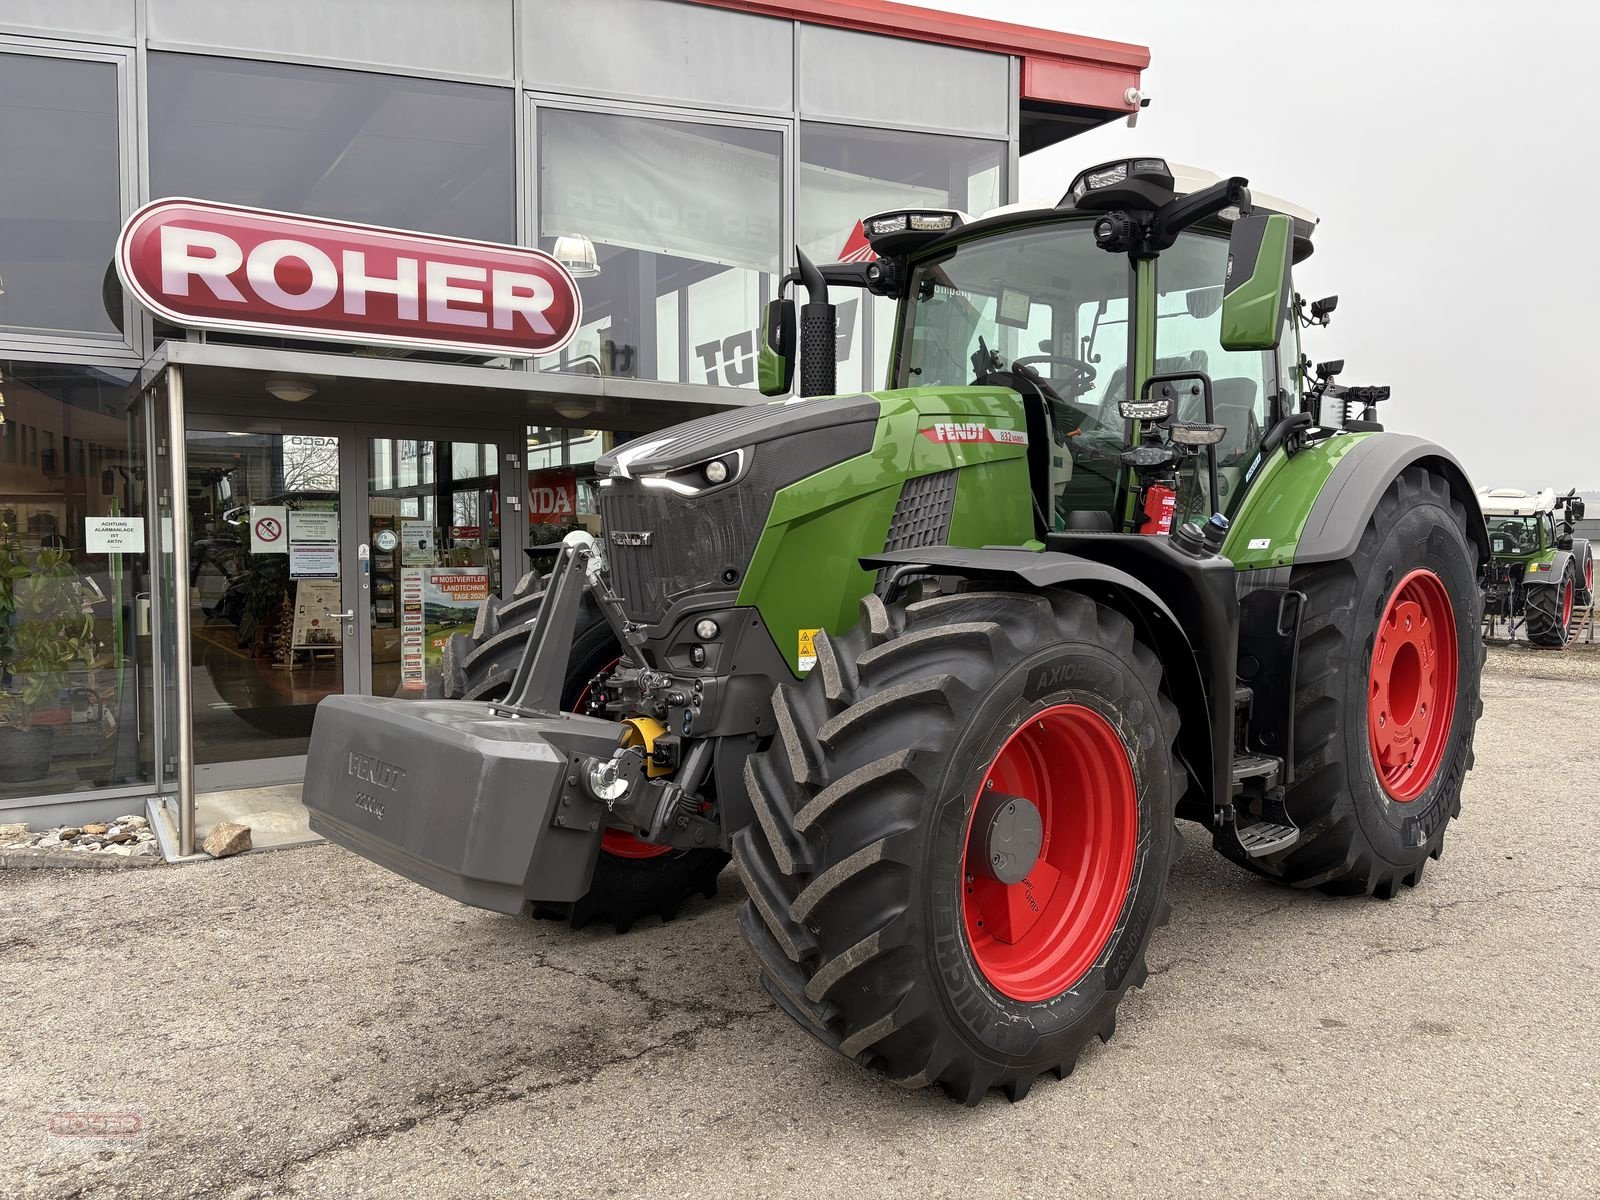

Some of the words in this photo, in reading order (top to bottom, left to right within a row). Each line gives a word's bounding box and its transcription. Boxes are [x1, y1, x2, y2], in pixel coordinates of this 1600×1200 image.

[160, 225, 557, 335] ROHER
[933, 284, 972, 300] ompany
[935, 423, 986, 441] FENDT
[1000, 431, 1012, 442] 832
[439, 575, 486, 583] MOSTVIERTLER
[443, 584, 486, 592] LANDTECHNIK
[348, 751, 407, 792] FENDT
